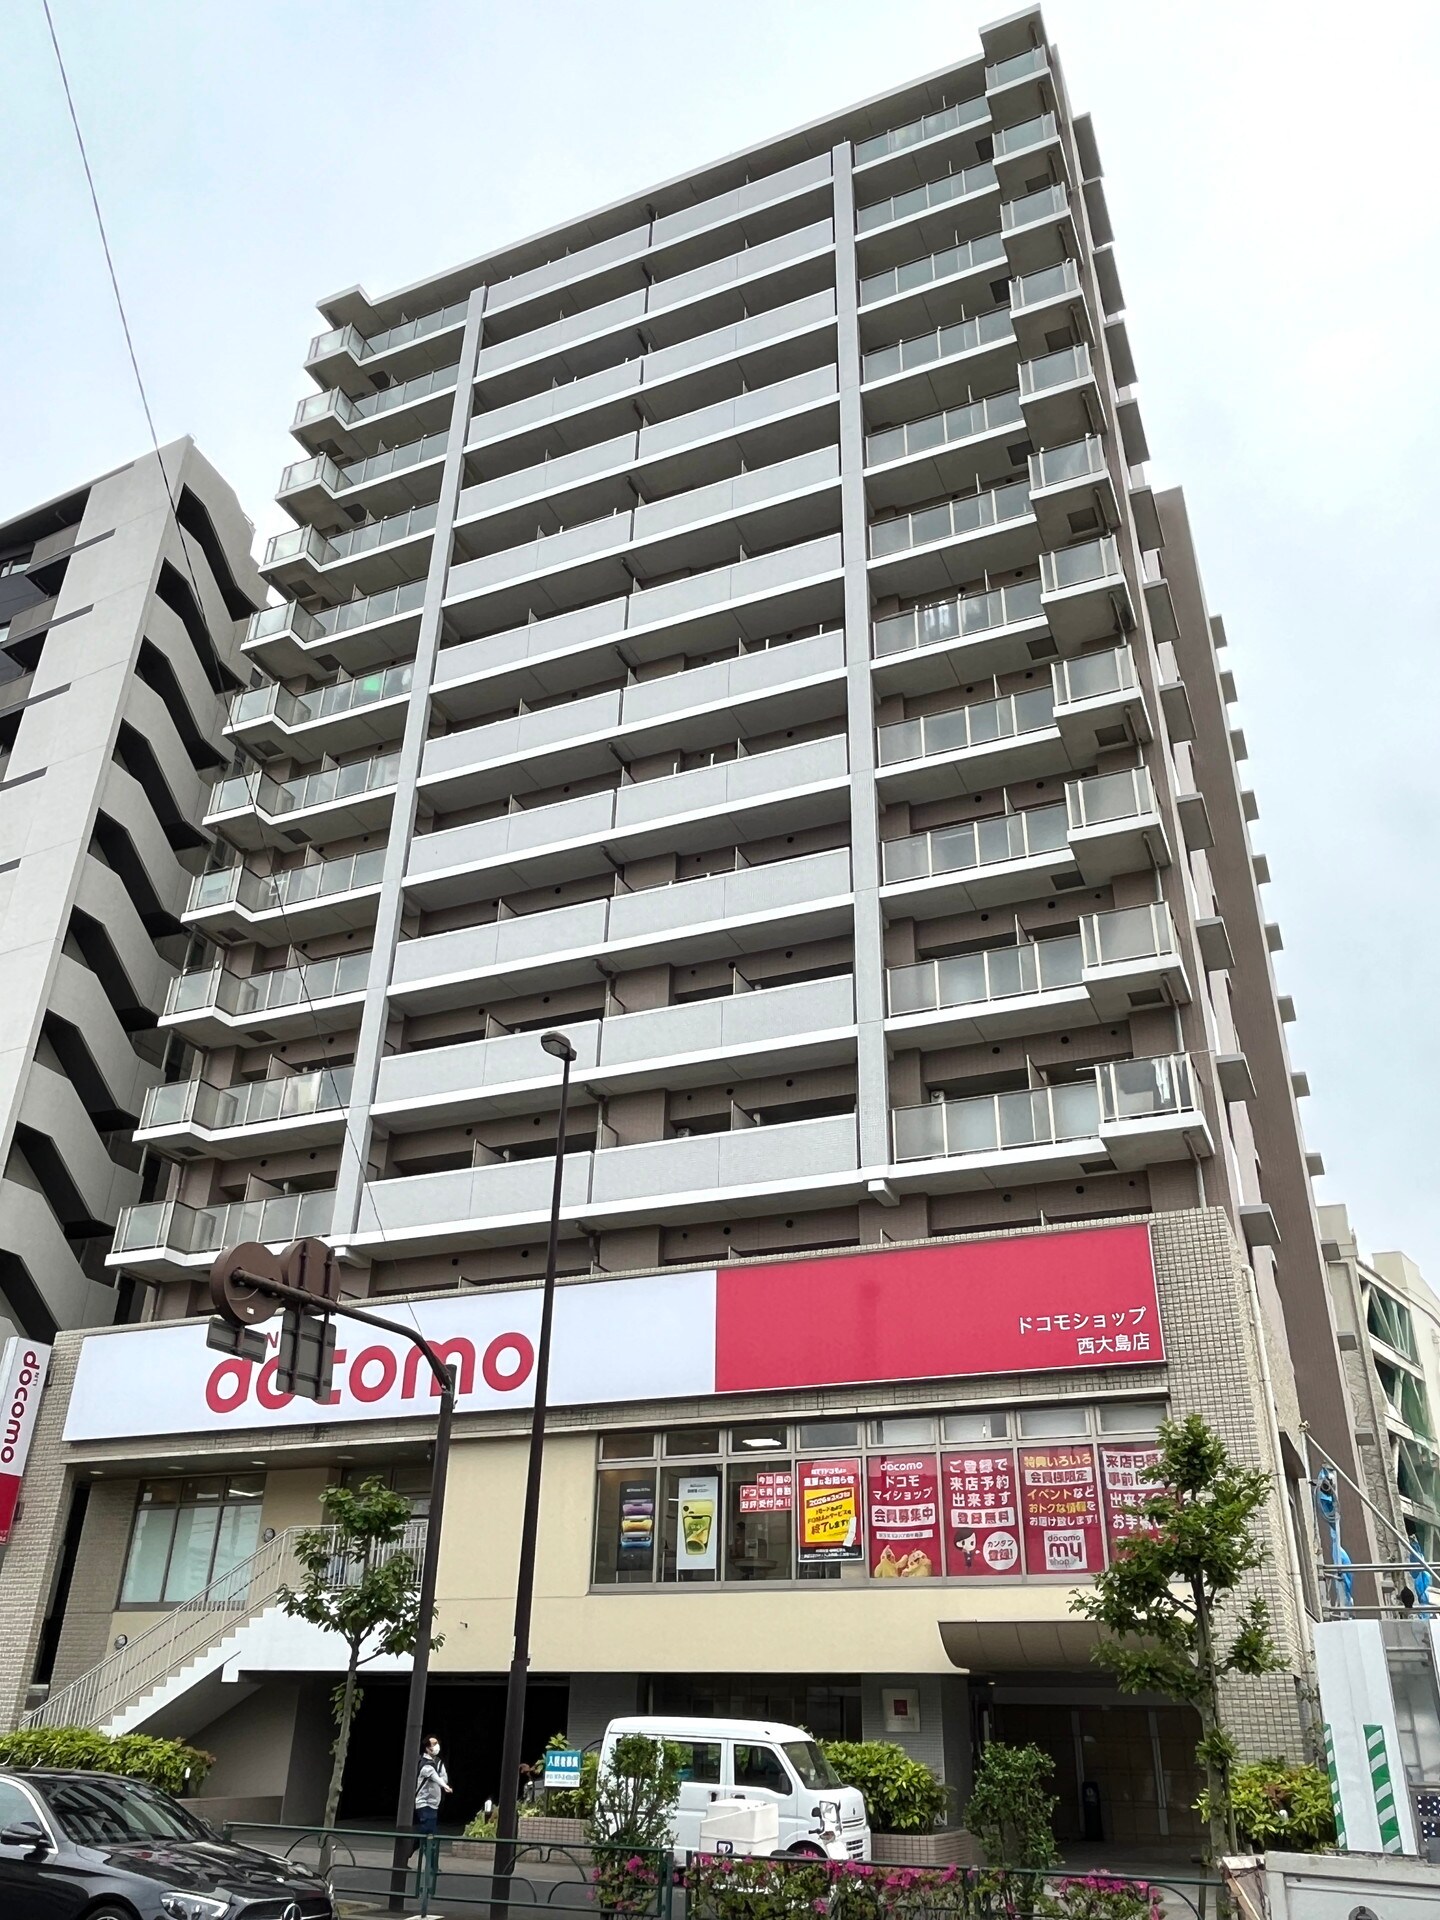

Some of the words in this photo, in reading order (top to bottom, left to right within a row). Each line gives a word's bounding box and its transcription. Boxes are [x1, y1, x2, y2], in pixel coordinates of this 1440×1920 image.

[1019, 1306, 1147, 1335] ドコモショップ
[1076, 1332, 1150, 1355] 西大島店
[0, 1350, 41, 1464] docomo
[880, 1461, 923, 1472] docomo
[949, 1458, 1008, 1474] ご登録で
[886, 1474, 920, 1488] ドコモ
[950, 1474, 1009, 1491] 来店予約
[1030, 1469, 1088, 1484] 会員様限定
[872, 1486, 933, 1501] マイショップ
[952, 1491, 1012, 1507] 出来ます
[1027, 1485, 1095, 1501] イベントなど
[874, 1506, 933, 1523] 会員募集中
[1028, 1501, 1096, 1514] おトクな情報を
[987, 1539, 1014, 1548] カンタン
[1047, 1534, 1081, 1542] docomo
[1049, 1542, 1083, 1563] my
[1049, 1558, 1071, 1568] shop
